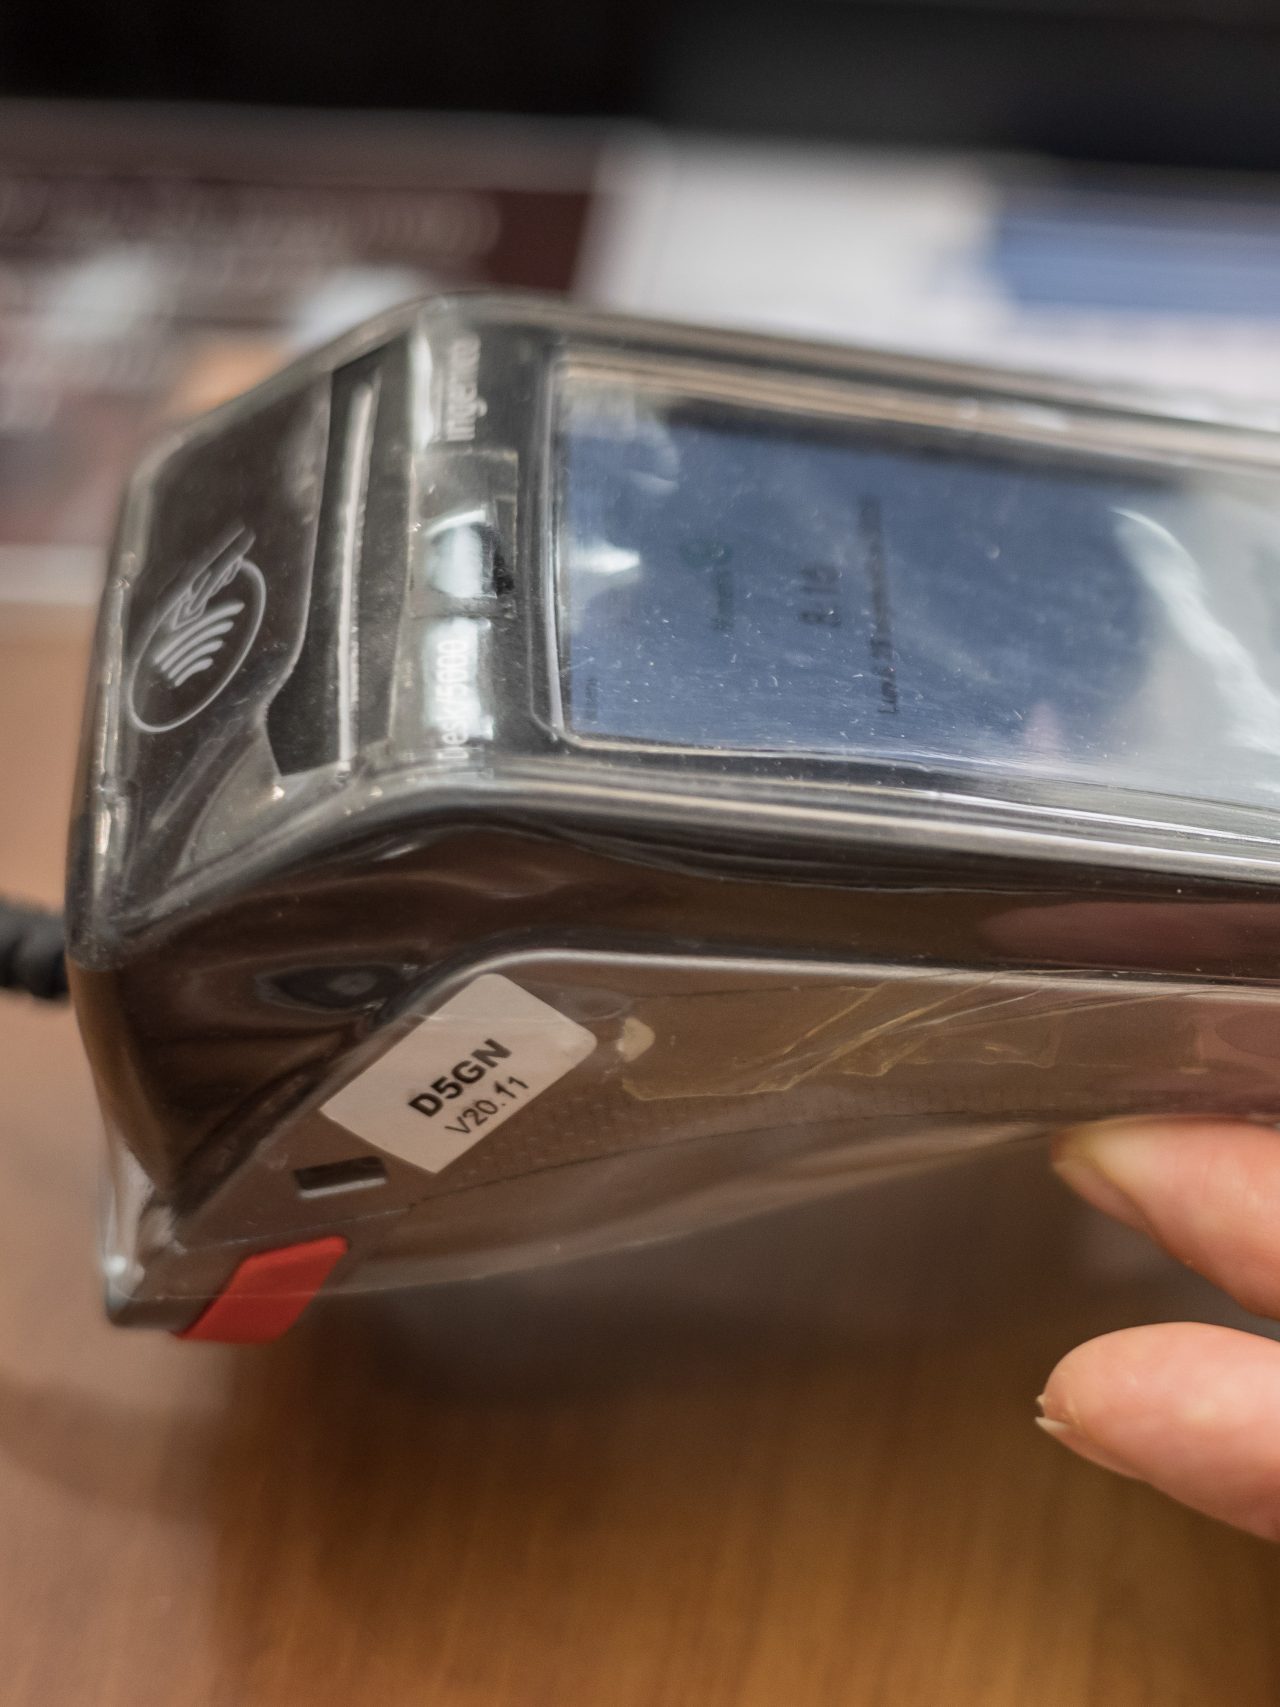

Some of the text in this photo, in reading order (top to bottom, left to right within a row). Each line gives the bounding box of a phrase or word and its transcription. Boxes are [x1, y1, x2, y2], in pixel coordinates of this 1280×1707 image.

[434, 639, 469, 762] Desk/5000
[407, 1038, 513, 1118] D5GN
[444, 1076, 530, 1135] V20.11
